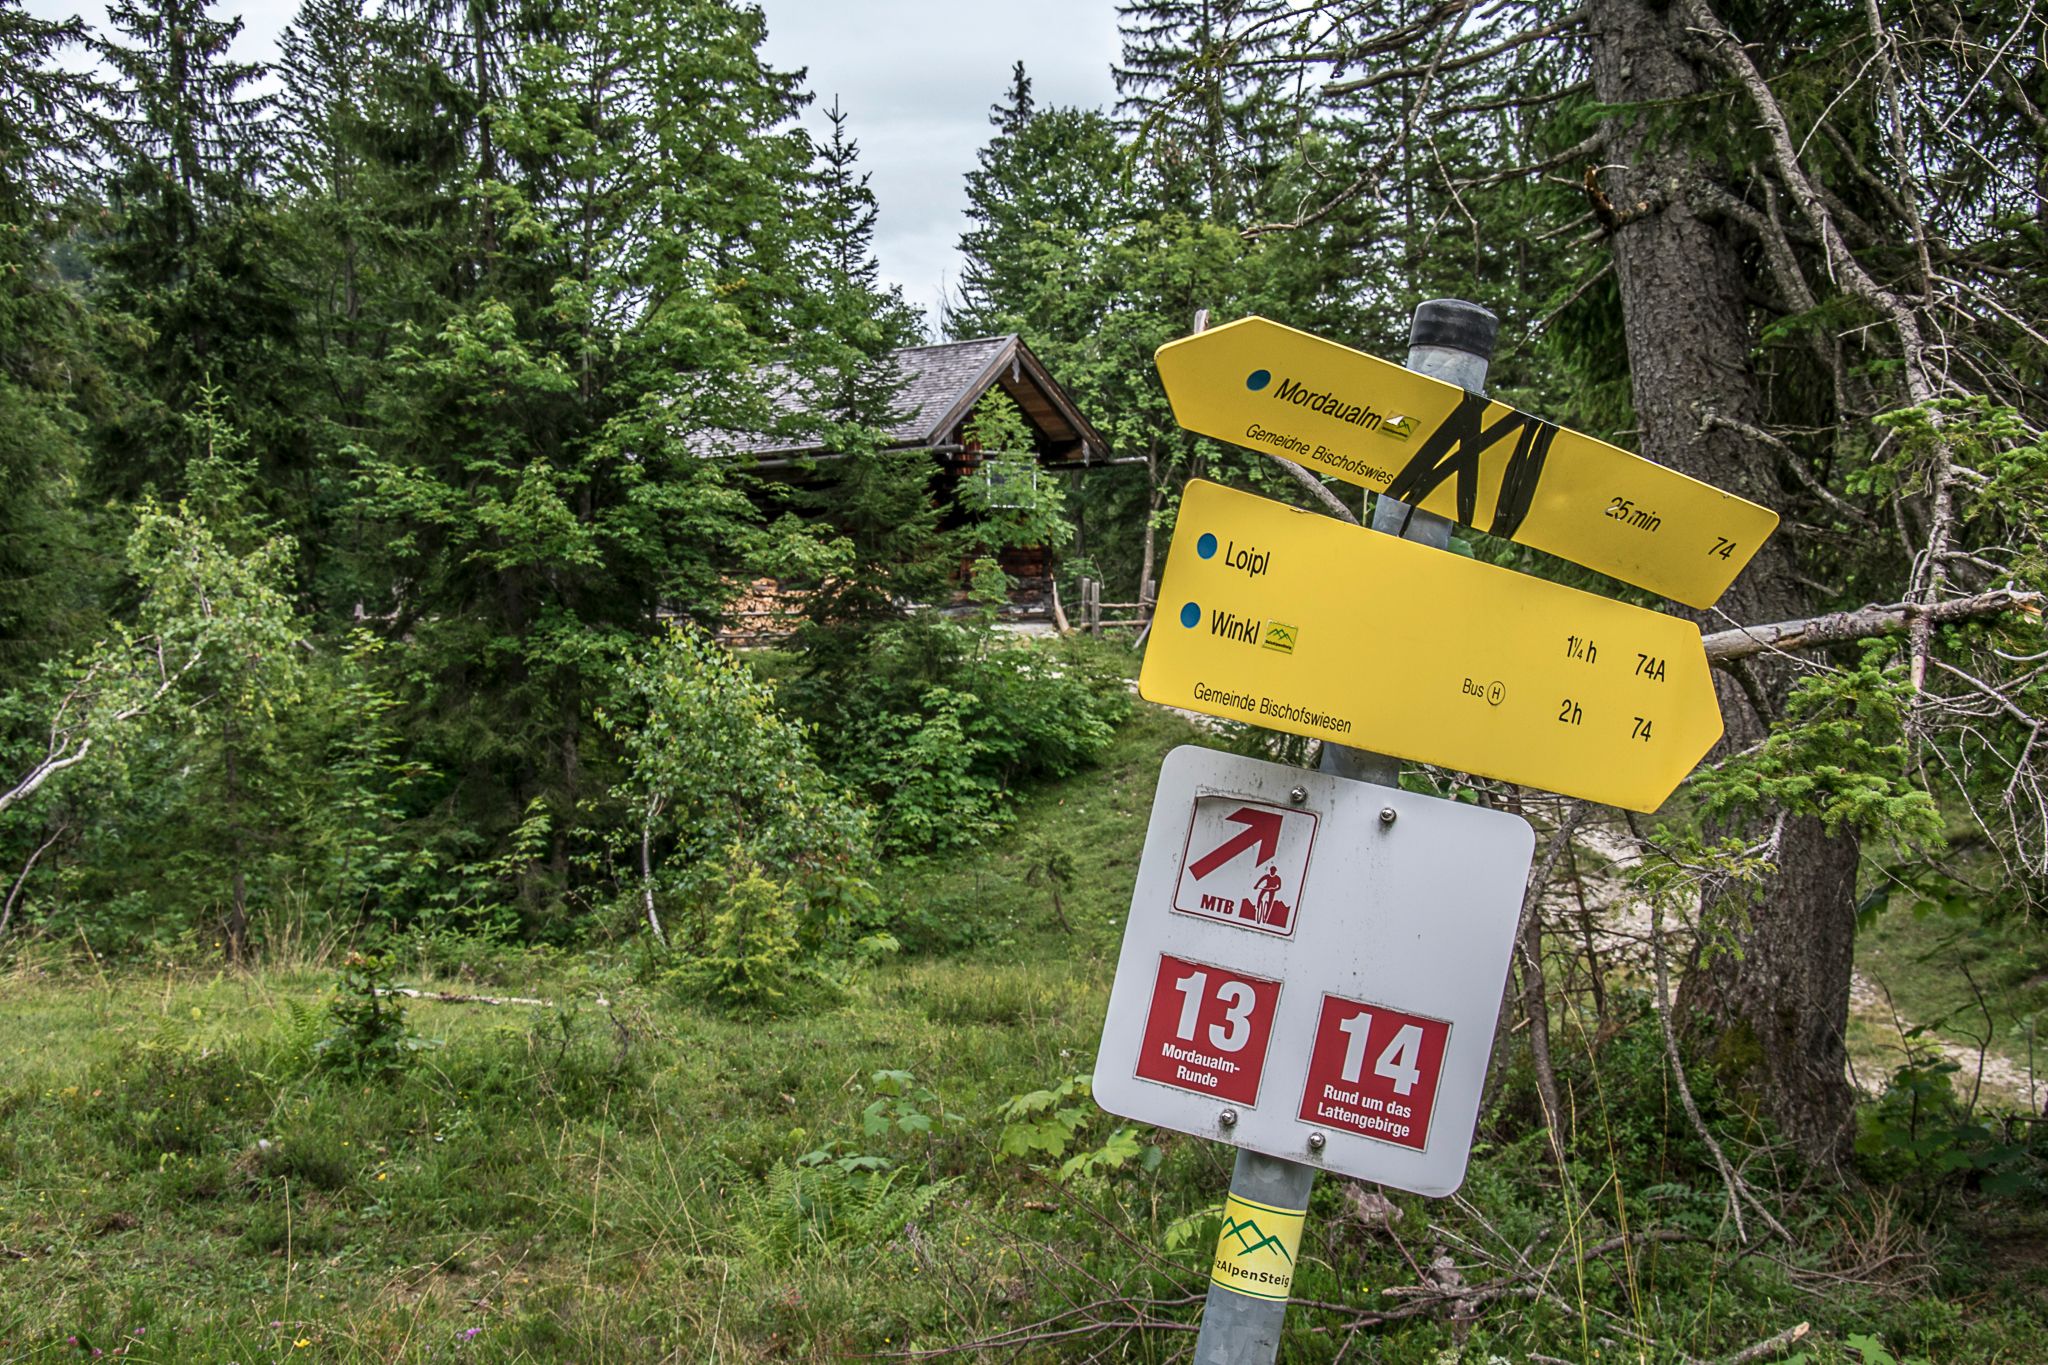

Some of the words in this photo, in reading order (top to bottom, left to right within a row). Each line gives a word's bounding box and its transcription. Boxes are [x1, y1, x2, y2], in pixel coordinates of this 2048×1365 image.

[1274, 378, 1382, 430] Mordaualm
[1246, 423, 1310, 455] Gemeidne
[1311, 445, 1394, 485] Bischofswies
[1225, 541, 1270, 577] Loipl
[1707, 537, 1737, 560] 74
[1211, 610, 1260, 645] Winkl
[1635, 653, 1665, 682] 74A
[1462, 678, 1484, 697] Bus
[1194, 682, 1256, 711] Gemeinde
[1259, 698, 1352, 733] Bischofswiesen
[1632, 717, 1652, 742] 74
[1200, 894, 1235, 915] MTB
[1175, 971, 1256, 1053] 13
[1161, 1043, 1240, 1074] Mordaualm-
[1339, 1012, 1424, 1096] 14
[1176, 1064, 1218, 1088] Runde
[1324, 1084, 1359, 1106] Rund
[1361, 1096, 1385, 1112] um
[1386, 1101, 1412, 1119] das
[1317, 1102, 1411, 1137] Lattengebirge
[1216, 1258, 1290, 1288] zAlpenSteig
